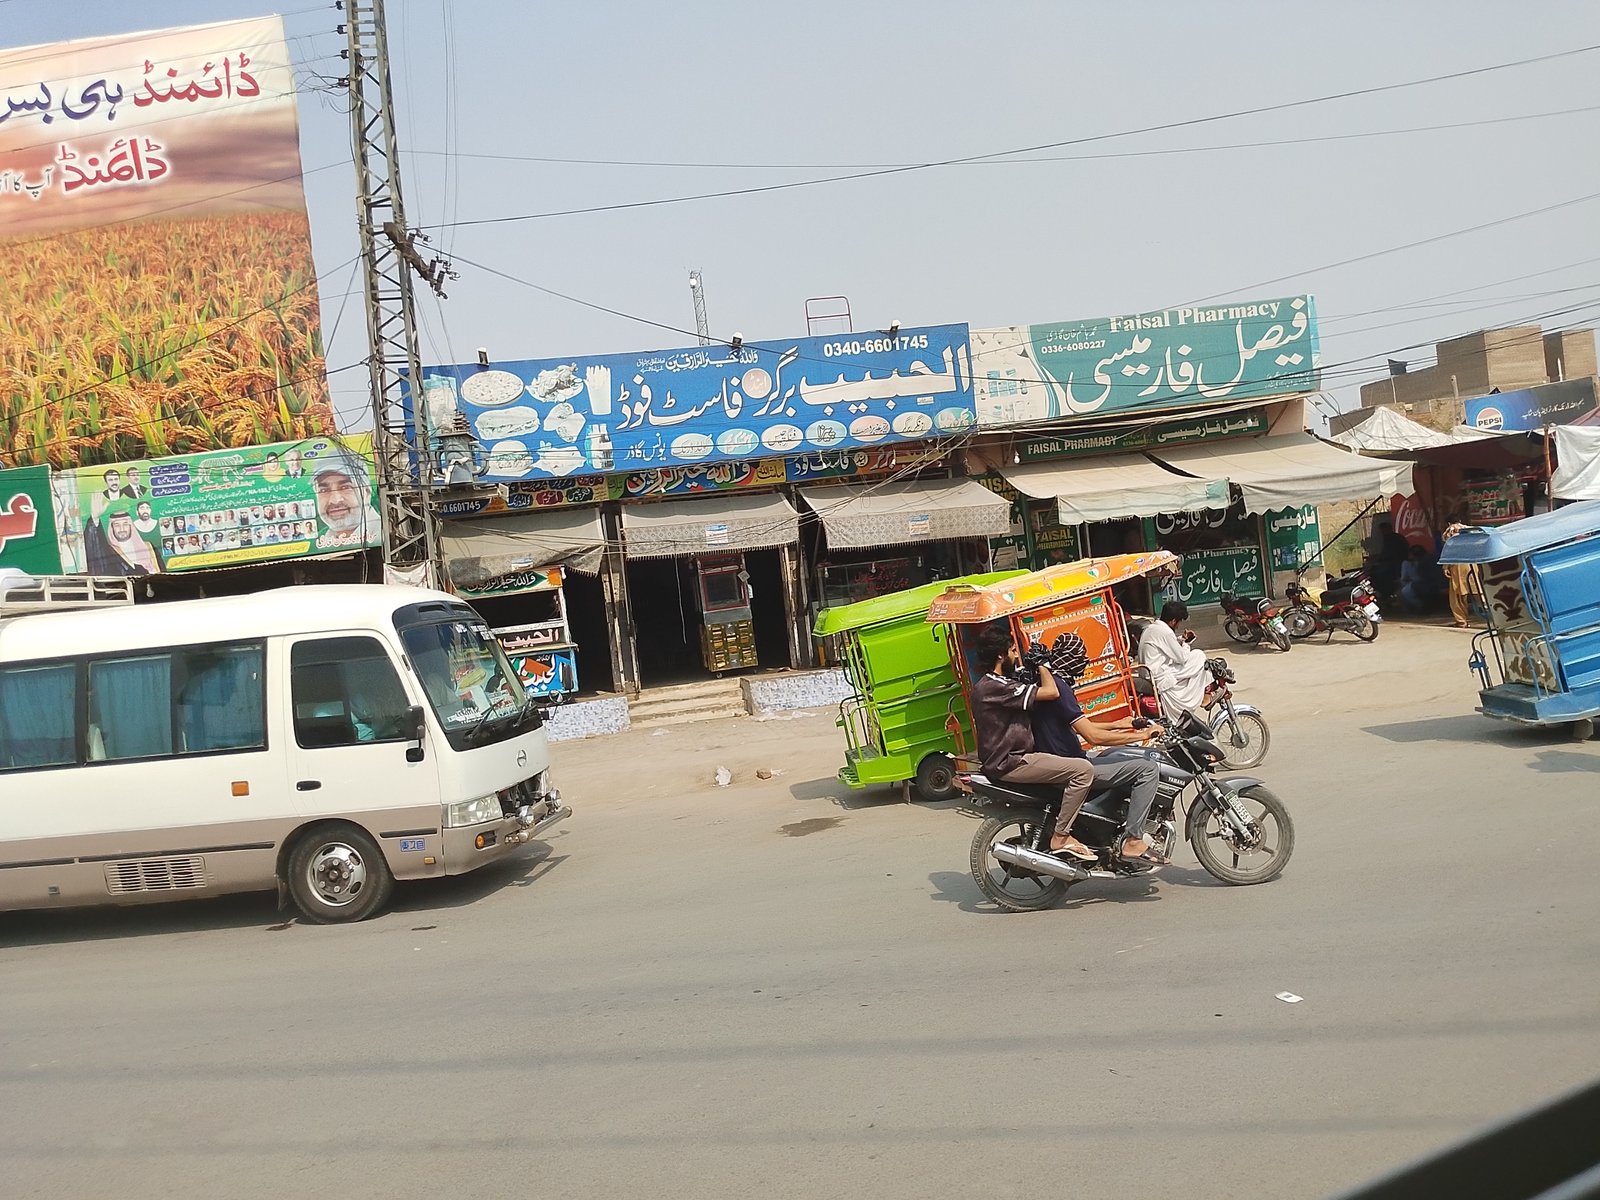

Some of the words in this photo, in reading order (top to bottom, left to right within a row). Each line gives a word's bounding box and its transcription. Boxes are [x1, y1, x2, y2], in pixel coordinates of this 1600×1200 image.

[133, 53, 261, 107] ڈائمنڈ
[61, 79, 124, 121] ہی
[58, 137, 168, 192] ڈائمنڈ
[26, 168, 52, 198] آپ
[1109, 310, 1171, 333] Faisal
[1176, 301, 1281, 326] Pharmacy
[823, 334, 928, 358] 0340-6601745
[1041, 340, 1106, 354] 0336-6080227
[1197, 297, 1308, 398] فیصل
[753, 346, 798, 417] برگر
[799, 343, 971, 417] الحبیب
[615, 374, 652, 430] فوڈ
[648, 376, 742, 426] فاسٹ
[1477, 417, 1502, 426] PEPSI
[1027, 441, 1062, 455] FAISAL
[1063, 435, 1118, 451] PHARMACY
[1034, 528, 1074, 542] FAISAL
[1270, 506, 1316, 533] فارمیسی
[503, 628, 560, 648] الحبیب
